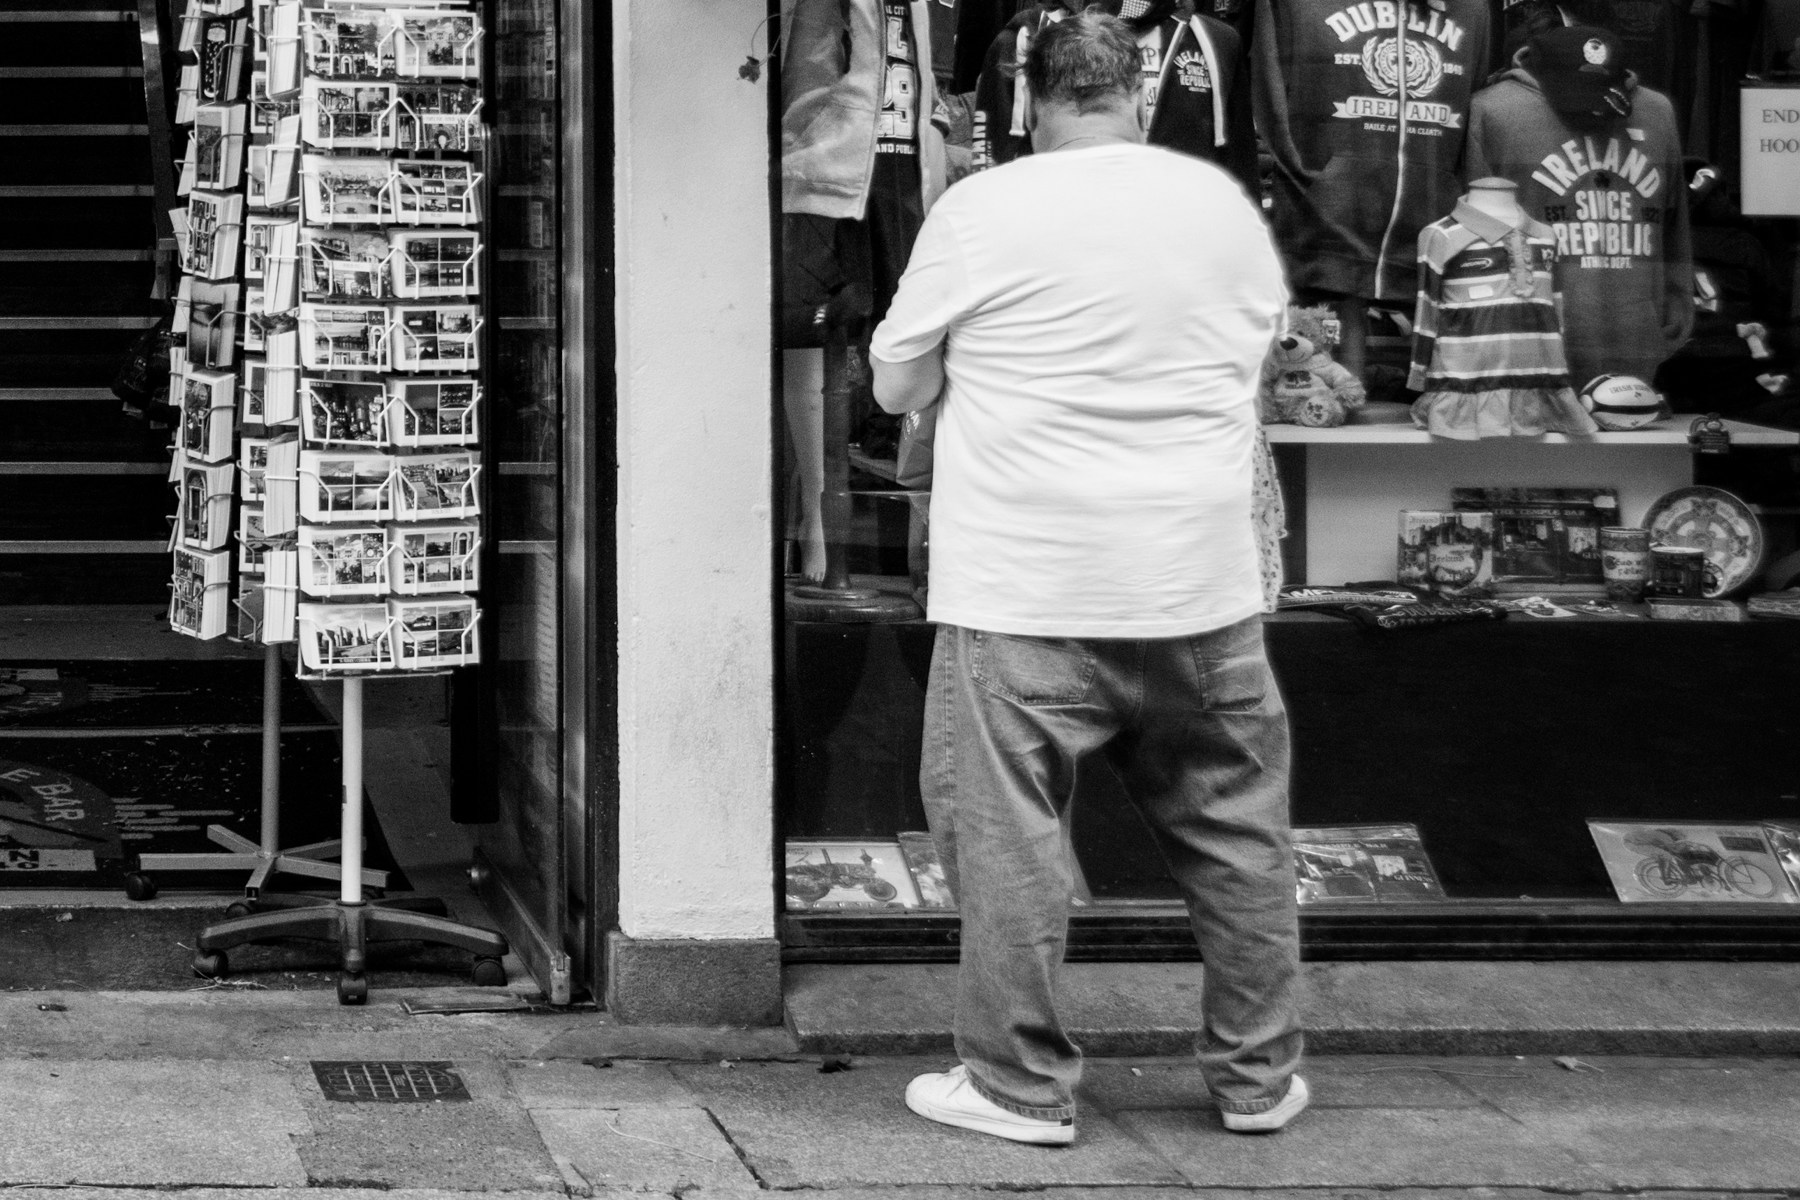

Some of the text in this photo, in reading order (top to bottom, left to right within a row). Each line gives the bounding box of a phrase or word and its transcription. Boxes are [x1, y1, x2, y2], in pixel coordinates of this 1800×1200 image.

[1324, 0, 1464, 52] DUBLIN
[1334, 54, 1362, 66] EST.
[1352, 99, 1449, 123] IRELAND
[1762, 108, 1800, 124] END
[1531, 135, 1661, 198] IRELAND
[1574, 190, 1632, 221] SINCE
[1552, 222, 1653, 257] REPUBLIC
[1519, 508, 1560, 516] TEMPLE
[30, 782, 85, 822] BAR
